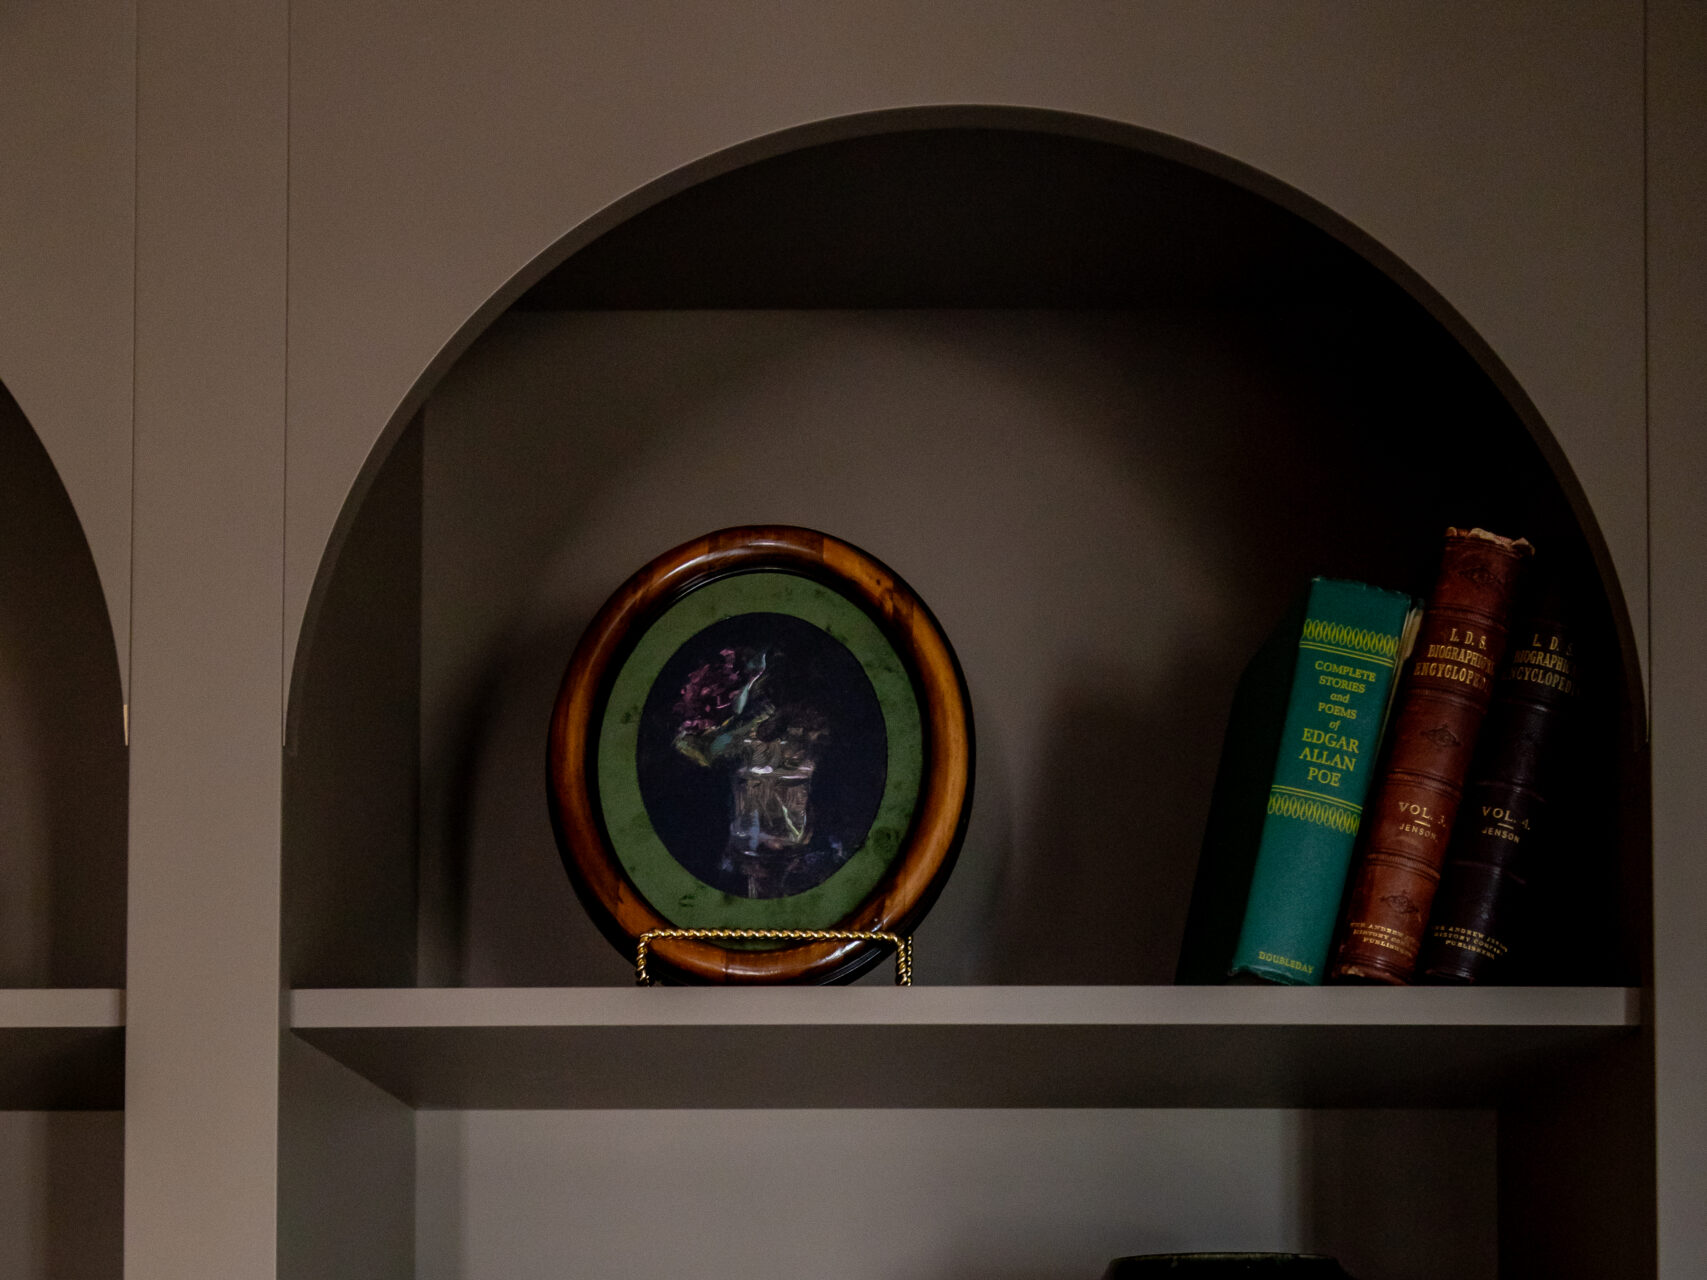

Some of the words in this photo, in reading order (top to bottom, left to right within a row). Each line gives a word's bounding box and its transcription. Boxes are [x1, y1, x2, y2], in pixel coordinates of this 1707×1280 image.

[1314, 660, 1376, 682] COMPLETE
[1318, 675, 1367, 694] STORIES
[1329, 692, 1350, 704] and
[1317, 702, 1358, 719] POEMS
[1328, 720, 1341, 731] of
[1301, 728, 1360, 754] EDGAR
[1298, 746, 1357, 772] ALLAN
[1307, 766, 1342, 787] POE
[1398, 801, 1433, 821] VOL.
[1481, 806, 1517, 823] VOL.
[1481, 827, 1521, 845] JENSON
[1258, 950, 1315, 975] DOUBLEDAY
